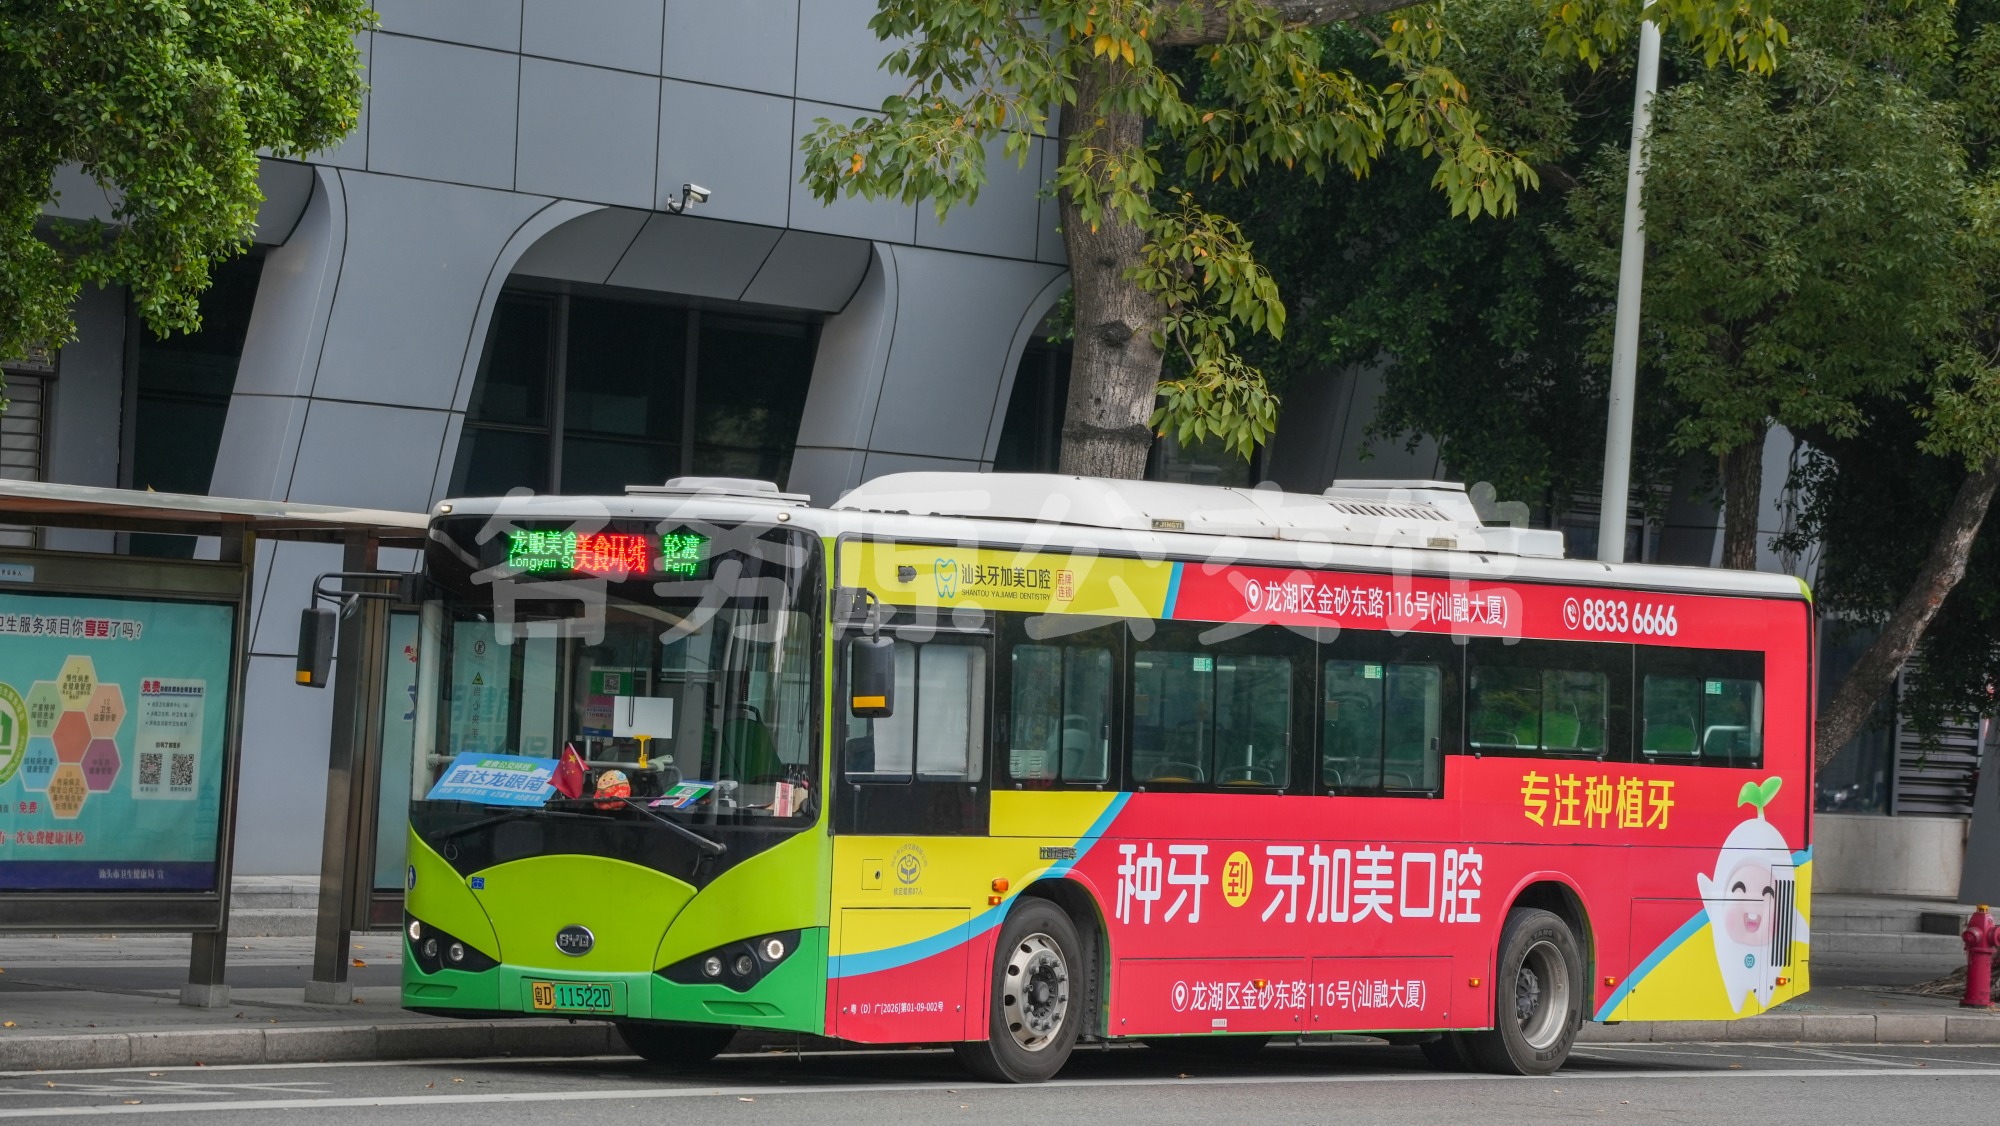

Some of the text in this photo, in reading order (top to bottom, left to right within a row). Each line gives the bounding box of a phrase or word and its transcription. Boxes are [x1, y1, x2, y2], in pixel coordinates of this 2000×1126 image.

[574, 534, 645, 572] 美食环线
[664, 535, 699, 559] 轮渡
[509, 555, 557, 571] Longyan
[665, 559, 696, 576] Ferry
[961, 563, 1051, 589] 汕头牙加美口腔
[961, 589, 990, 597] SHANTOU
[1019, 592, 1051, 600] DENTISTRY
[1264, 580, 1508, 629] 龙湖区金砂东路116号(汕融大厦)
[1582, 598, 1678, 637] 8833 6666
[447, 769, 548, 792] 直达龙眼南
[1520, 771, 1675, 830] 专注种植牙
[1115, 842, 1483, 925] 种牙 到 牙加美口腔
[559, 934, 589, 948] BYD
[1190, 980, 1426, 1012] 龙湖区金砂东路116号(汕融大厦)
